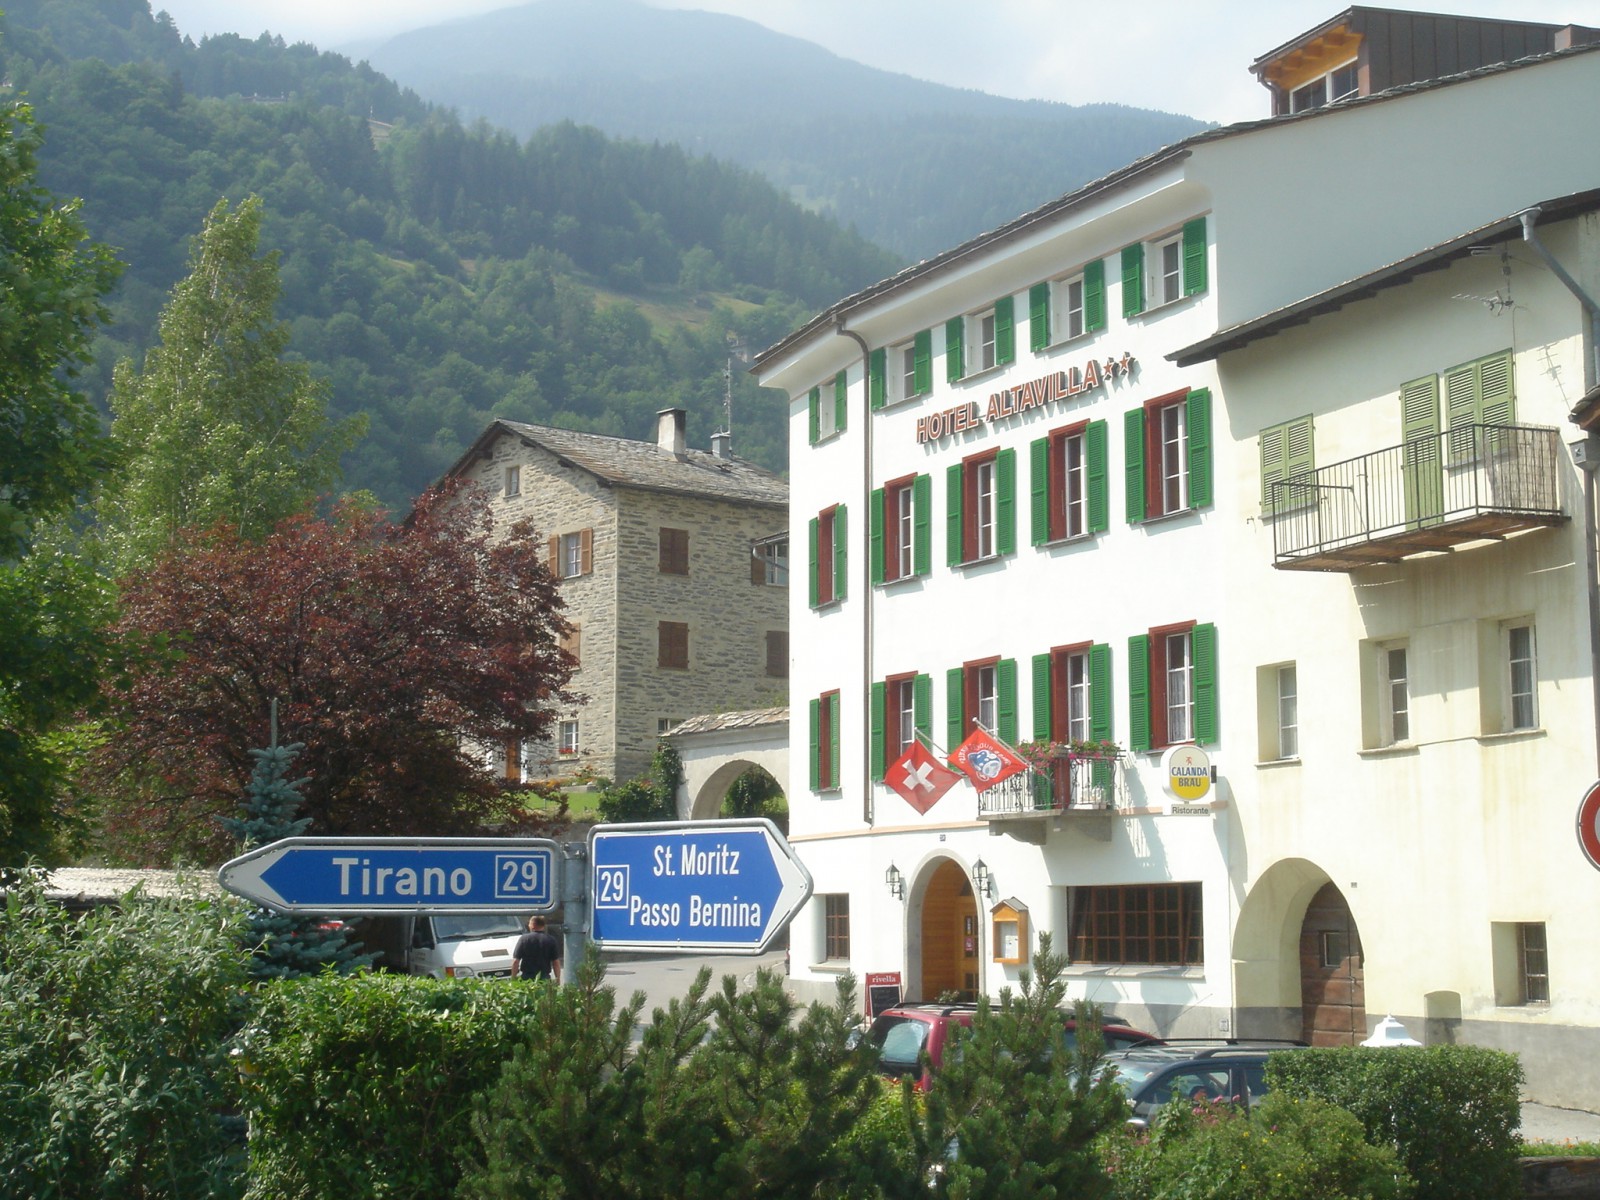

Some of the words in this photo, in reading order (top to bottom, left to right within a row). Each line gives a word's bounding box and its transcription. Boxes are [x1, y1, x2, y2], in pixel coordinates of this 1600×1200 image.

[917, 401, 979, 443] HOTEL
[986, 359, 1099, 422] ALTAVILLA
[1171, 766, 1208, 776] CALANDA
[1172, 806, 1209, 815] Ristorante
[653, 844, 676, 877] St.
[681, 843, 740, 876] Moritz
[332, 857, 472, 896] Tirano
[502, 861, 538, 891] 29
[600, 870, 624, 902] 29
[629, 895, 681, 926] Passo
[689, 894, 761, 927] Bernina
[872, 975, 896, 983] rivella
